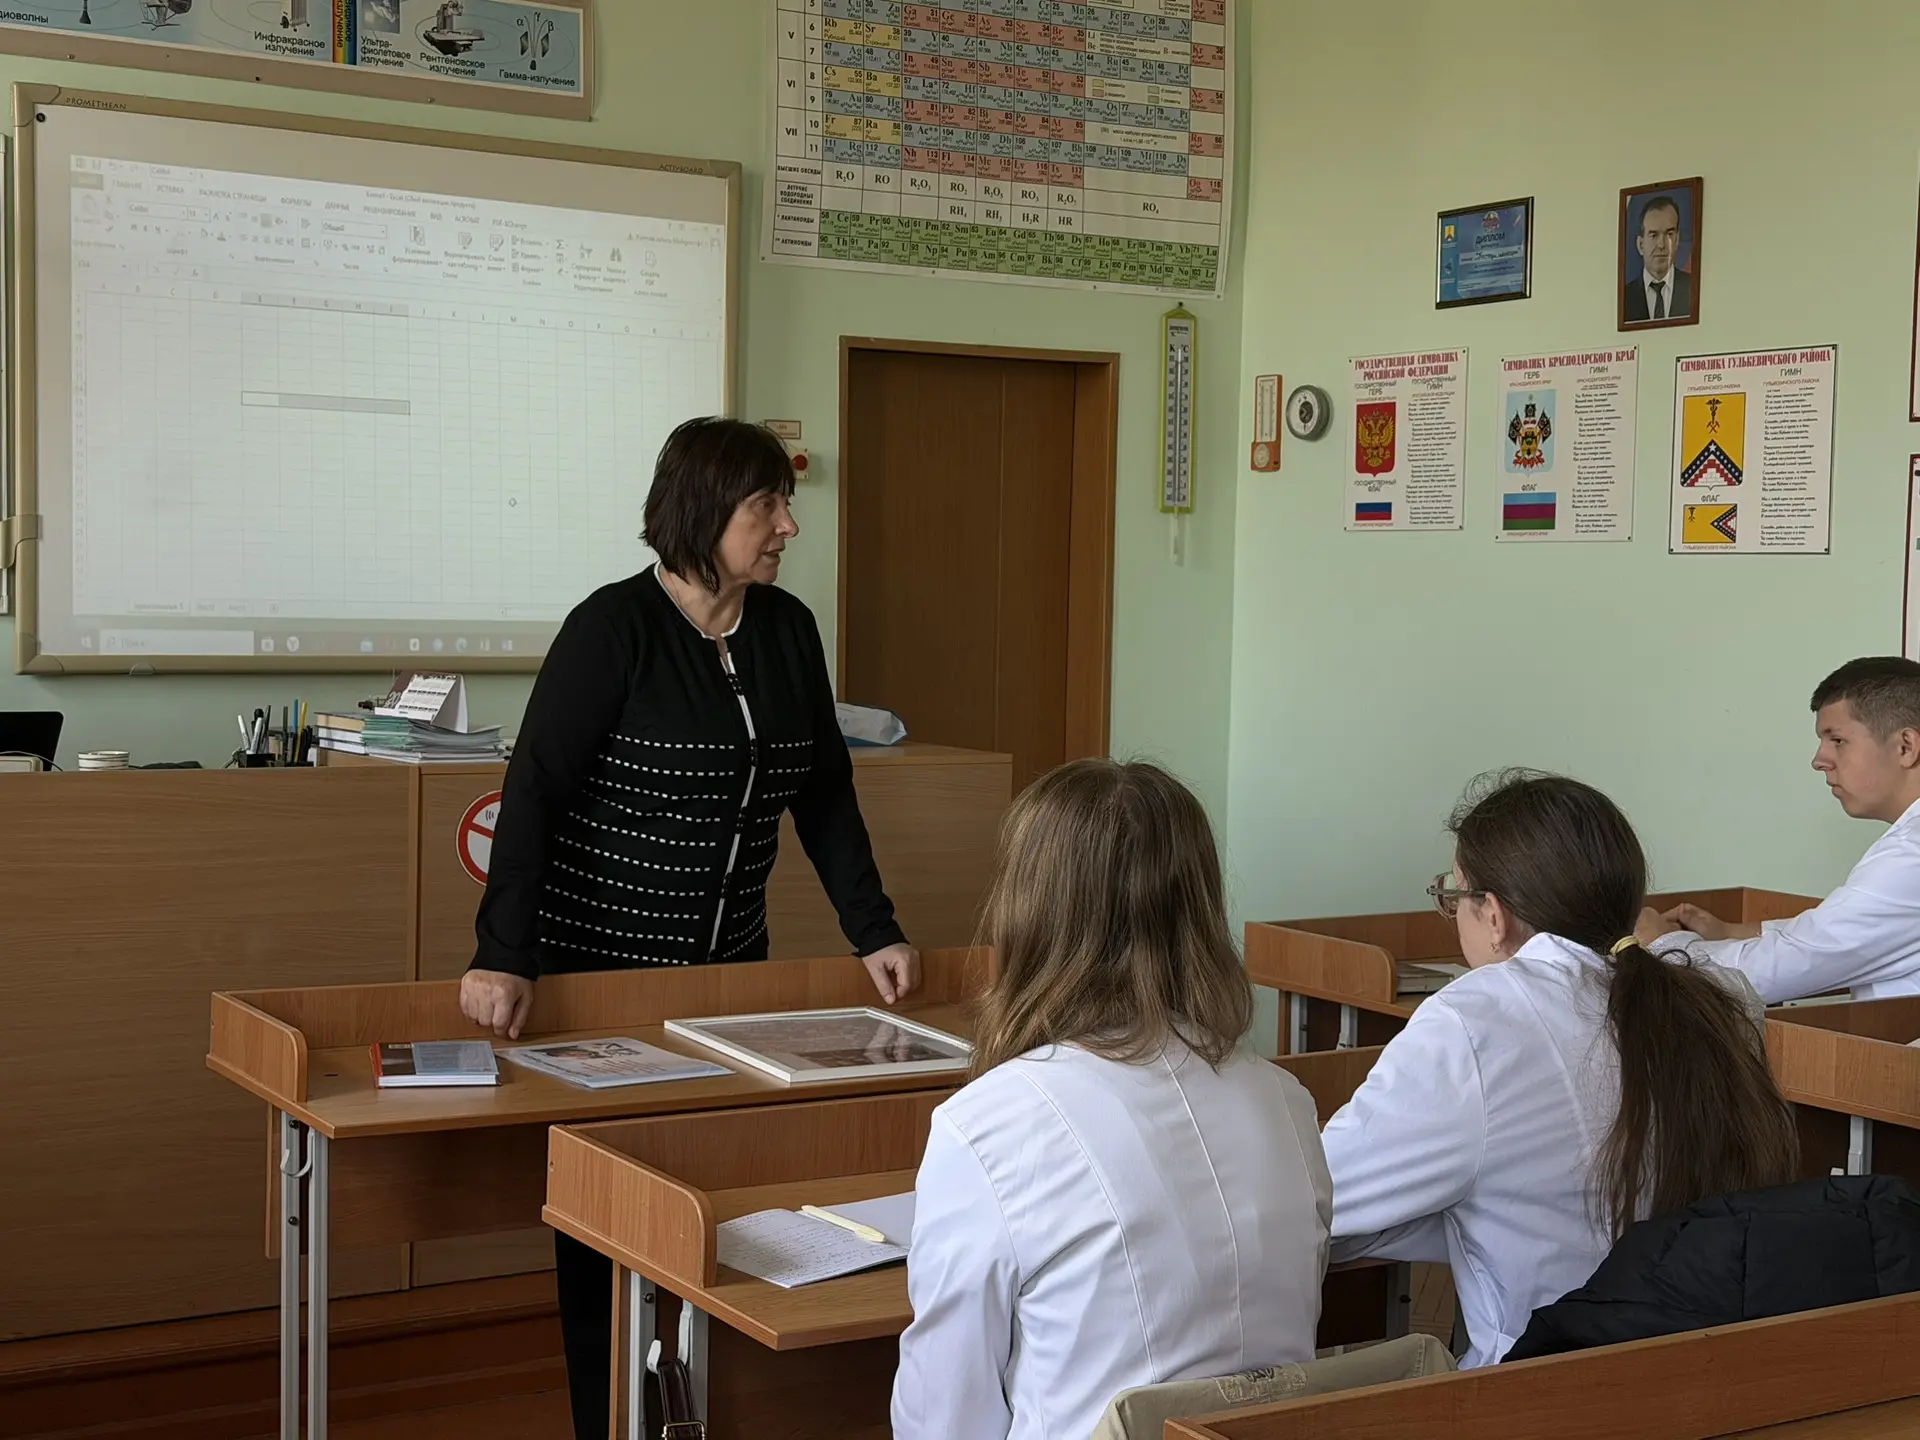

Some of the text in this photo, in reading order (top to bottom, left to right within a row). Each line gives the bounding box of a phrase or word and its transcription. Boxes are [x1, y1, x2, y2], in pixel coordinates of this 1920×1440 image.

[904, 5, 938, 17] Ga 31
[968, 14, 976, 22] 32
[809, 23, 815, 31] 6
[824, 18, 862, 30] Rb 37
[865, 24, 900, 35] Sr 38
[1077, 29, 1084, 38] 35
[254, 31, 325, 49] Инфракрасное
[787, 31, 796, 40] V
[903, 29, 939, 42] 39 Y
[941, 34, 976, 47] 40 Zr
[361, 36, 392, 48] Ультра-
[824, 42, 832, 50] 47
[265, 43, 315, 57] излучение
[361, 46, 411, 60] фиолетовое
[809, 47, 815, 55] 7
[1016, 44, 1024, 52] 42
[865, 47, 900, 61] 48 Cd
[904, 52, 939, 64] In 49
[361, 56, 404, 68] излучение
[420, 52, 485, 69] Рентгеновское
[967, 61, 976, 69] 50
[1121, 58, 1130, 66] 45
[429, 64, 476, 77] излучение
[824, 66, 863, 78] Cs 55
[499, 69, 575, 87] Гамма-излучение
[866, 72, 900, 83] Ba 56
[904, 76, 912, 84] 57
[786, 79, 796, 88] VI
[809, 95, 816, 103] 9
[825, 90, 862, 103] 79 Au
[865, 95, 874, 103] 80
[66, 97, 126, 110] PROMETHEAN
[930, 103, 938, 111] 81
[941, 102, 976, 115] Pb 82
[825, 113, 862, 126] Fr 87
[1004, 112, 1013, 120] 83
[809, 120, 819, 128] 10
[865, 119, 901, 130] Ra 88
[785, 127, 798, 136] VII
[942, 128, 954, 136] 104
[809, 144, 818, 152] 11
[824, 139, 837, 147] 111
[1051, 140, 1062, 148] 107
[866, 143, 900, 155] 112 Cn
[904, 147, 938, 159] Nh 113
[777, 165, 822, 176] ВЫСШИЕ ОКСИДЫ
[875, 174, 890, 184] RO
[780, 190, 814, 199] ВОДОРОДНЫЕ
[837, 212, 849, 223] Ce
[1058, 216, 1073, 227] HR
[954, 224, 969, 234] Sm
[1010, 252, 1026, 262] Cm
[1169, 344, 1175, 352] K
[1354, 351, 1459, 370] ГОСУДАРСТВЕННАЯ СИМВОЛИКА
[1503, 349, 1635, 372] СИМВОЛИКА КРАСНОДАРСКОГО КРАЯ
[1680, 349, 1831, 372] СИМВОЛИКА ГУЛЬКЕВИЧСКОГО РАЙОНА
[1363, 364, 1449, 381] РОССИЙСКОЙ ФЕДЕРАЦИИ
[1589, 365, 1608, 374] ГИМН
[1780, 368, 1802, 377] ГИМН
[1524, 371, 1540, 379] ГЕРБ
[1703, 374, 1722, 383] ГЕРБ
[1368, 388, 1383, 396] ГЕРБ
[1426, 383, 1443, 391] ГИМН
[1521, 483, 1537, 491] ФЛАГ
[1700, 494, 1720, 503] ФЛАГ
